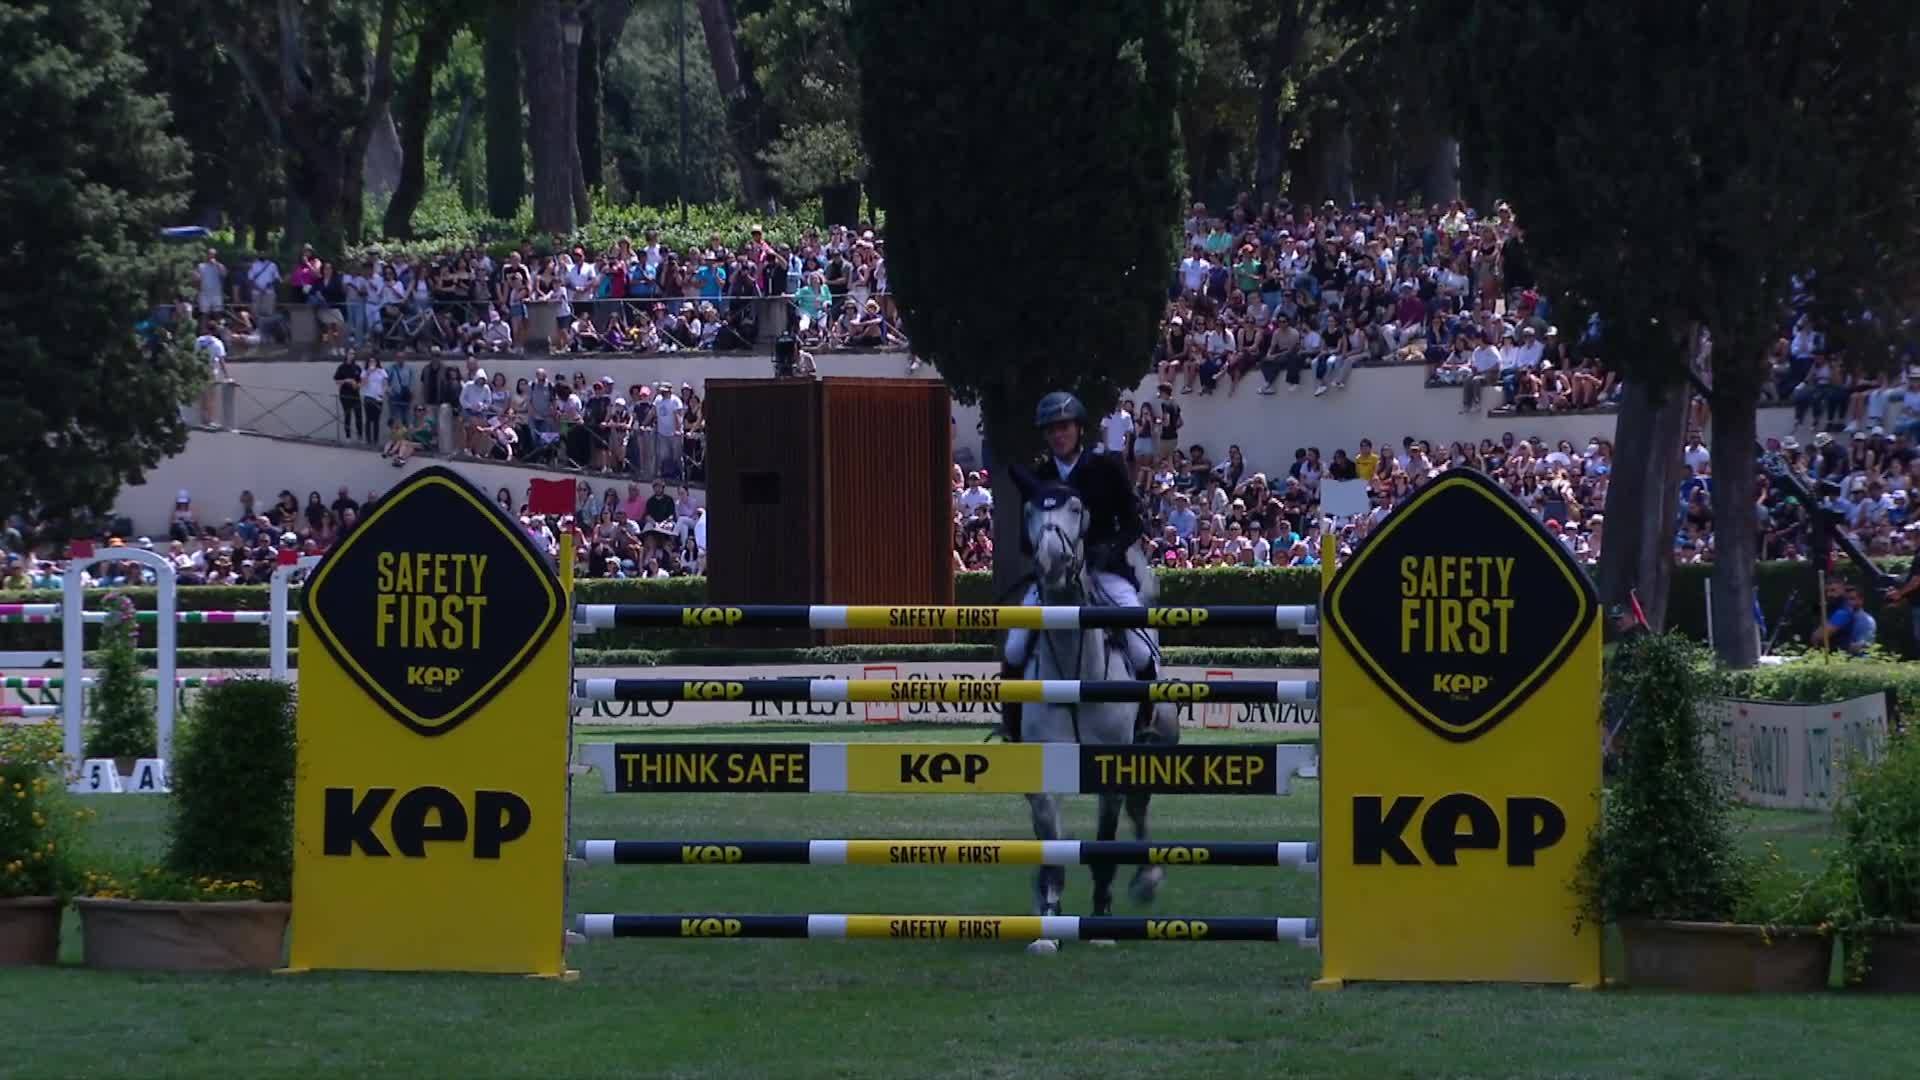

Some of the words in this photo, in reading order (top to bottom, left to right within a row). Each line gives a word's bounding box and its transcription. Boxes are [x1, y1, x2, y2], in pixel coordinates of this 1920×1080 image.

[377, 552, 487, 594] SAFETY
[1401, 556, 1515, 597] SAFETY
[376, 596, 488, 650] FIRST
[889, 608, 946, 628] SAFETY
[956, 608, 1000, 628] FIRST
[1401, 598, 1514, 654] FIRST
[890, 682, 946, 701] SAFETY
[957, 682, 1001, 701] FIRST
[90, 765, 101, 790] 5
[139, 765, 154, 789] A
[620, 753, 718, 784] THINK
[727, 753, 804, 784] SAFE
[1095, 755, 1193, 785] THINK
[1203, 755, 1264, 785] KEP
[889, 845, 946, 864] SAFETY
[957, 845, 1000, 864] FIRST
[889, 919, 946, 939] SAFETY
[958, 919, 1000, 939] FIRST
